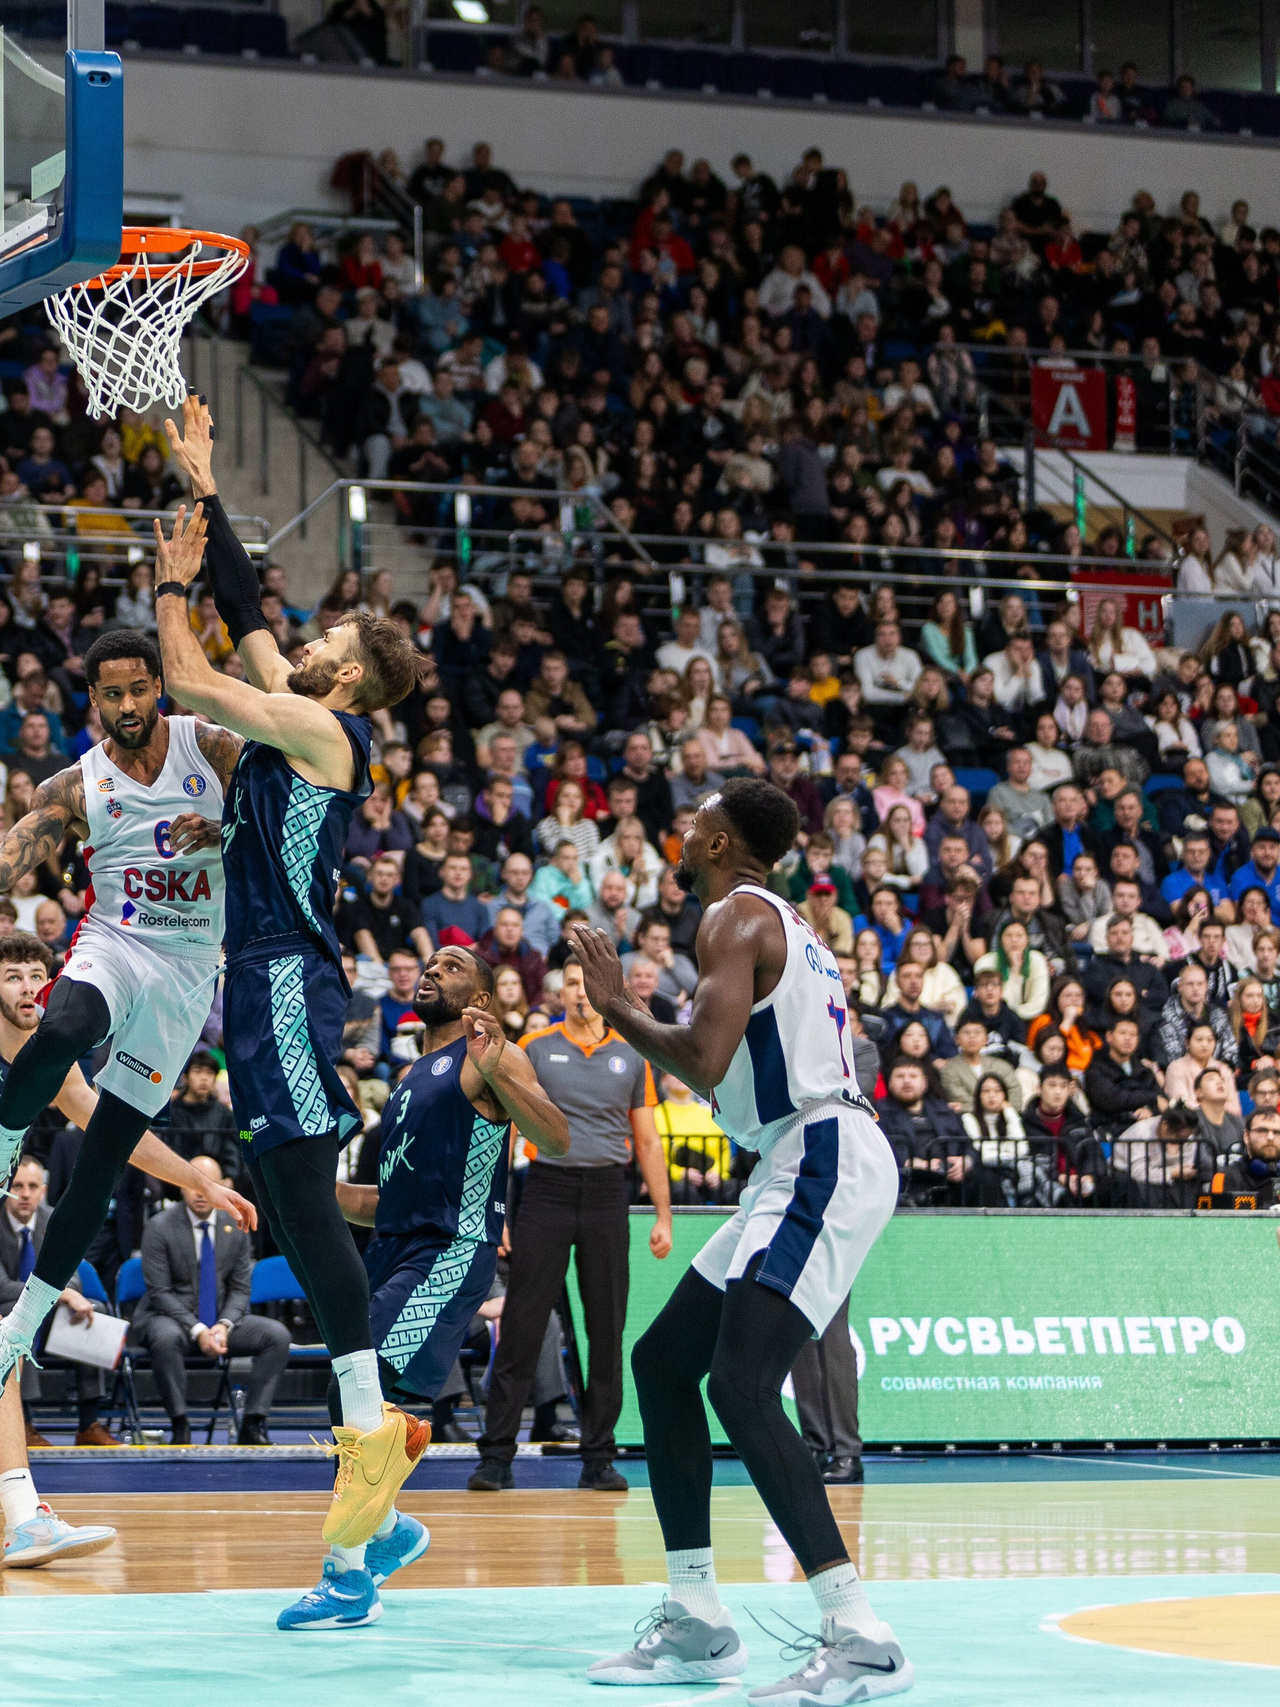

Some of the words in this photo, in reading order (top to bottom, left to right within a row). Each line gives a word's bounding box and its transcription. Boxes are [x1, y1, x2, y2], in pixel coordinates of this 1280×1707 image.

[154, 820, 177, 859] 6
[123, 867, 211, 902] CSKA
[138, 912, 210, 928] Rostelecom
[119, 1052, 150, 1076] Winline
[396, 1089, 412, 1125] 3
[868, 1316, 1247, 1356] РУСВЬЕТПЕТРО
[880, 1376, 1001, 1392] совместная
[1005, 1375, 1103, 1391] компания
